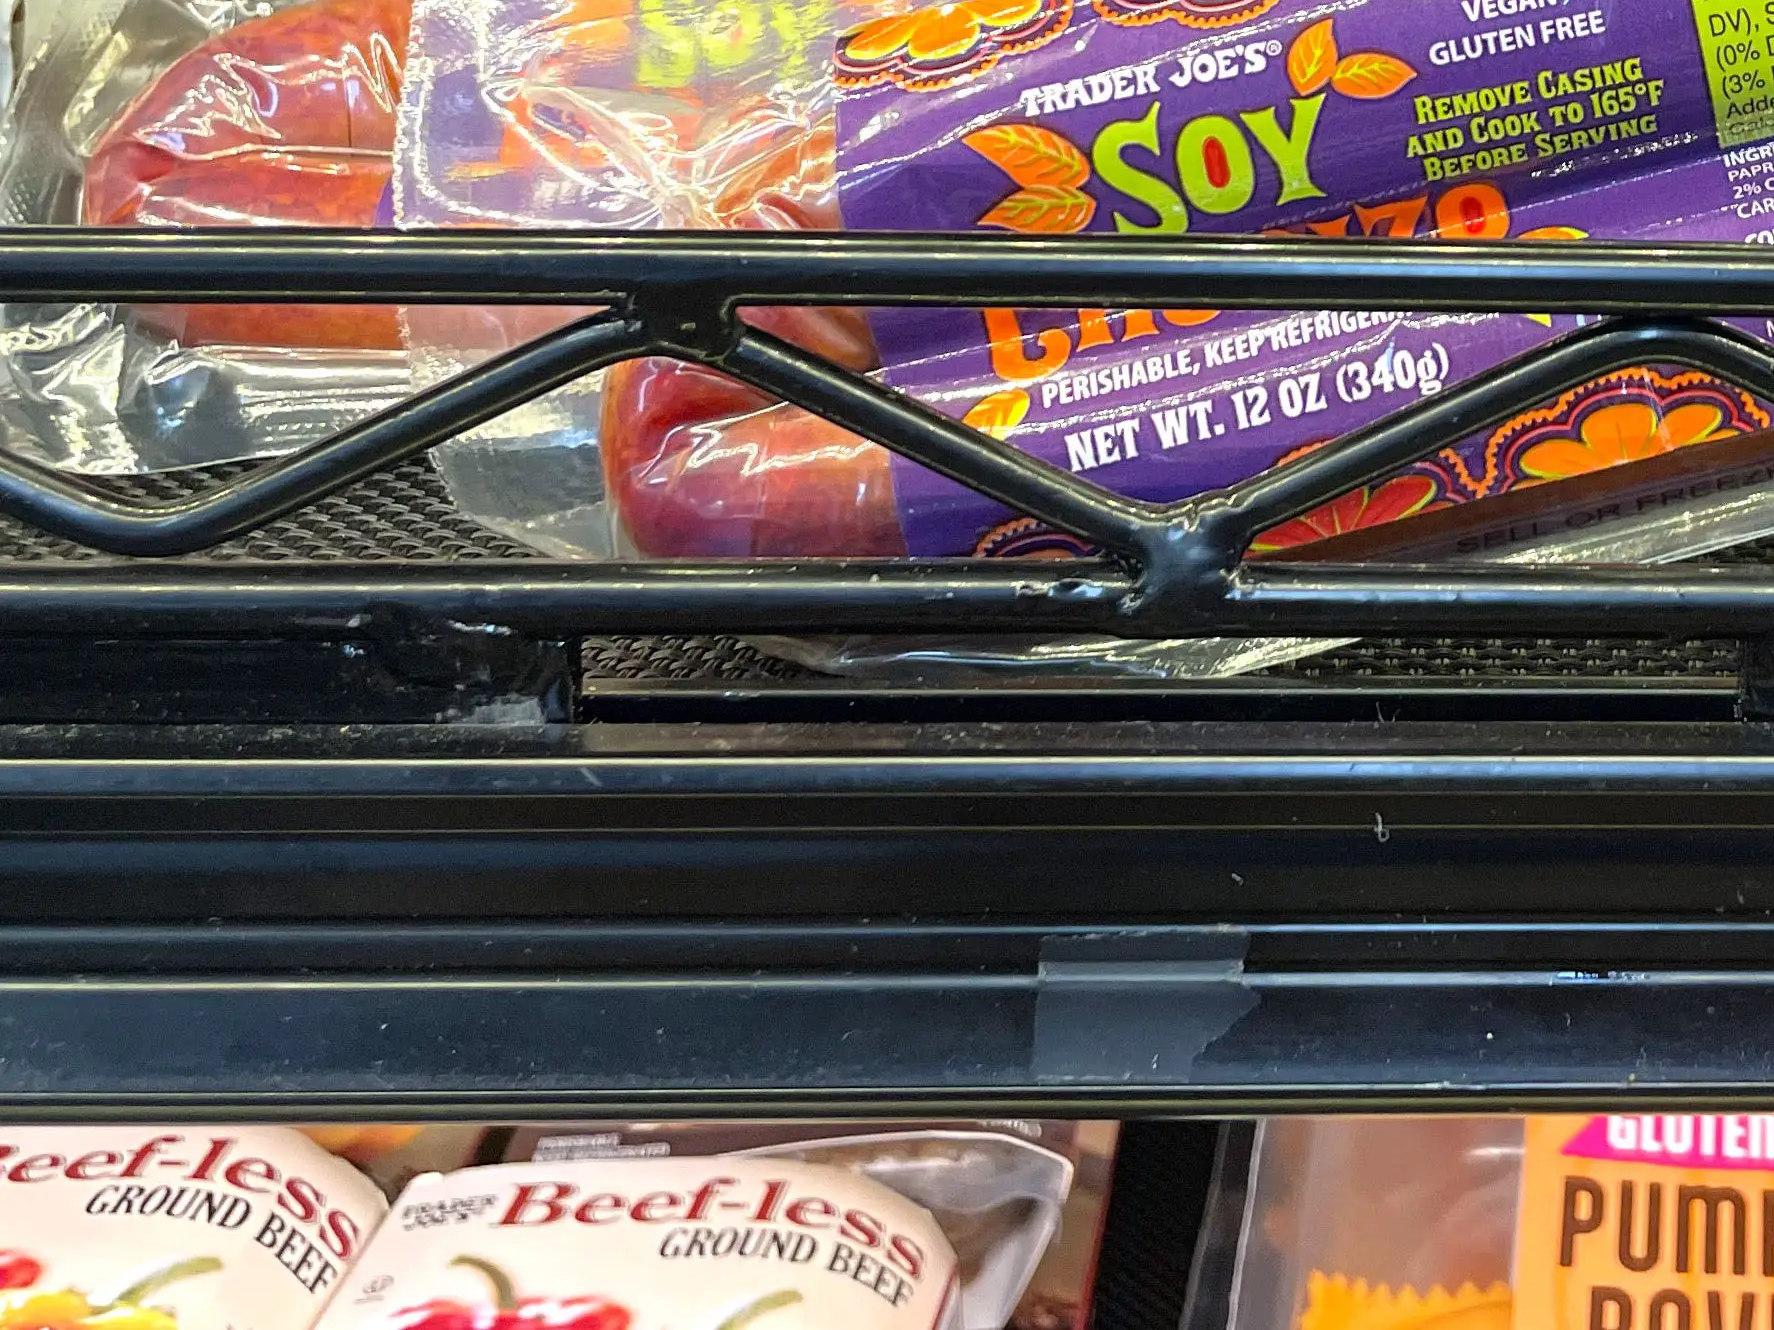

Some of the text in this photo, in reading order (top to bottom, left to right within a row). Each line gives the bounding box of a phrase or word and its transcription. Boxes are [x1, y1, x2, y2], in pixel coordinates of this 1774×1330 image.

[1429, 10, 1605, 64] GLUTEN FREE
[1716, 40, 1760, 72] (0%
[1019, 59, 1159, 116] TRADER
[1407, 80, 1663, 157] AND COOK TO 165°F
[1414, 58, 1642, 123] REMOVE CASING
[1722, 70, 1765, 99] (3%
[1092, 93, 1328, 233] SOY
[1423, 115, 1656, 180] BEFORE SERVING
[1732, 182, 1761, 199] 2%
[1042, 349, 1199, 407] PERISHABLE,
[1204, 330, 1262, 367] KEEP
[1064, 343, 1448, 471] NET WT. 12 OZ (340g)
[0, 1134, 360, 1262] eef-less
[498, 1175, 926, 1282] Beef-less
[86, 1183, 338, 1295] GROUND BEEF
[659, 1226, 914, 1309] GROUND BEEF
